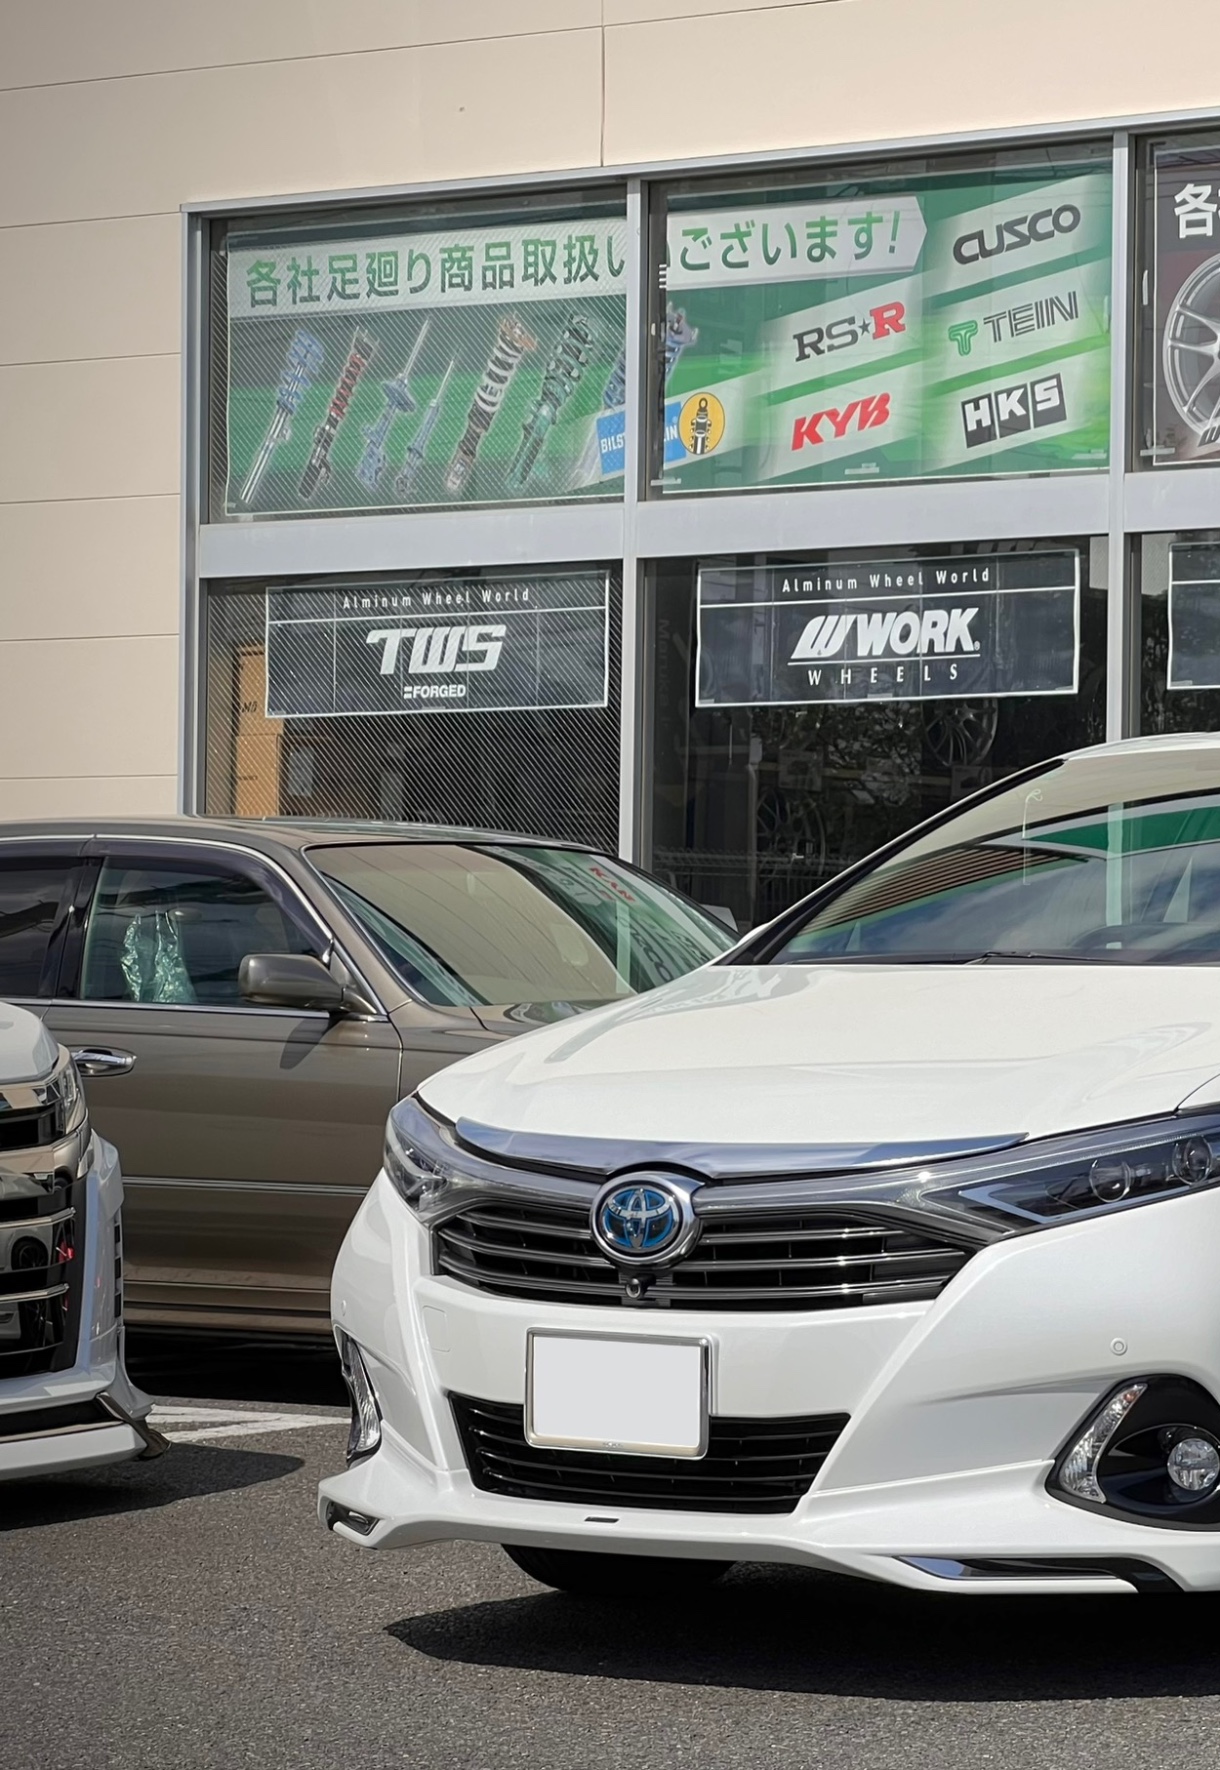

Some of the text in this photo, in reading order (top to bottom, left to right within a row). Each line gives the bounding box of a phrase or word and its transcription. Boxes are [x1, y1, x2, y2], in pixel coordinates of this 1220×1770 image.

[953, 203, 1081, 265] CUSCO
[983, 291, 1079, 343] TEIN
[791, 392, 891, 451] KYB
[963, 377, 1064, 438] HKS
[343, 588, 530, 608] Alminum Wheel World
[782, 567, 990, 593] Alminum Wheel World
[366, 624, 506, 675] TWS
[856, 607, 979, 657] WORK
[412, 684, 467, 699] FORGED
[808, 663, 958, 686] WHEELS
